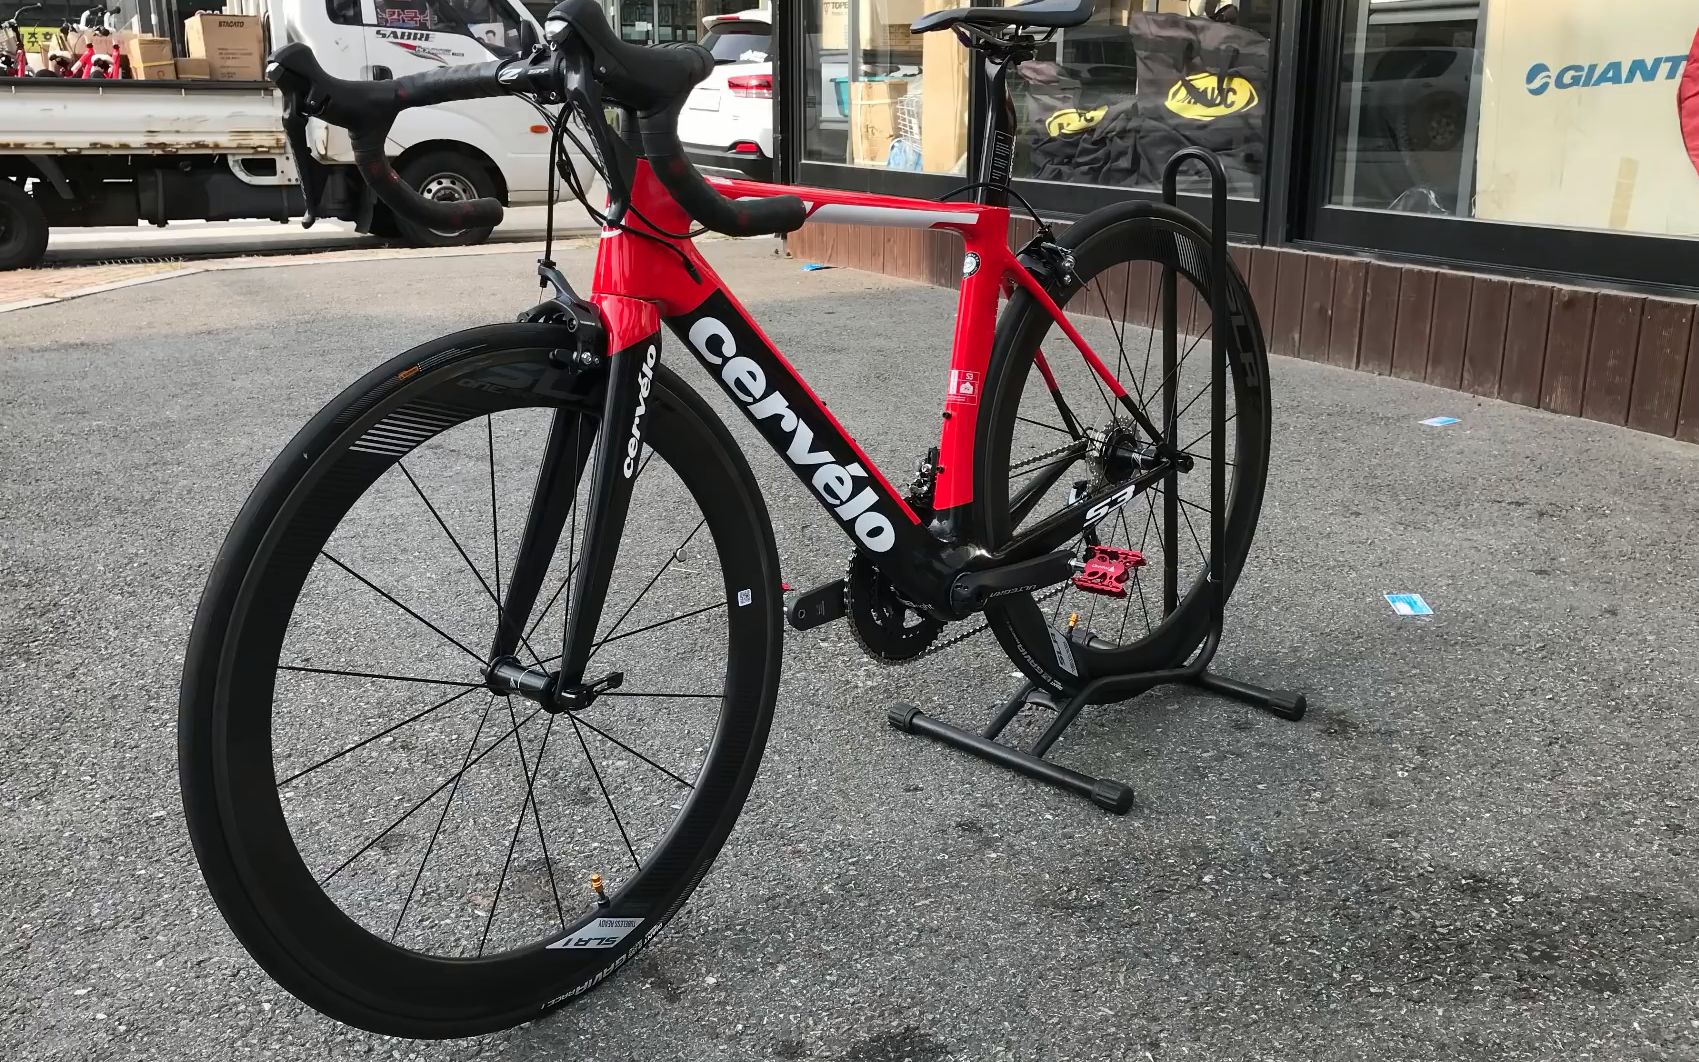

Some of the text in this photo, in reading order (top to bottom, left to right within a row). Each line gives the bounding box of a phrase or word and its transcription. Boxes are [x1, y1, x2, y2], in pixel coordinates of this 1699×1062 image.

[375, 29, 434, 42] SABRE
[1554, 54, 1688, 90] GIANT
[623, 343, 657, 479] cervélo
[689, 316, 896, 553] cervélo
[1083, 484, 1137, 528] S3
[574, 953, 627, 996] GAVIA
